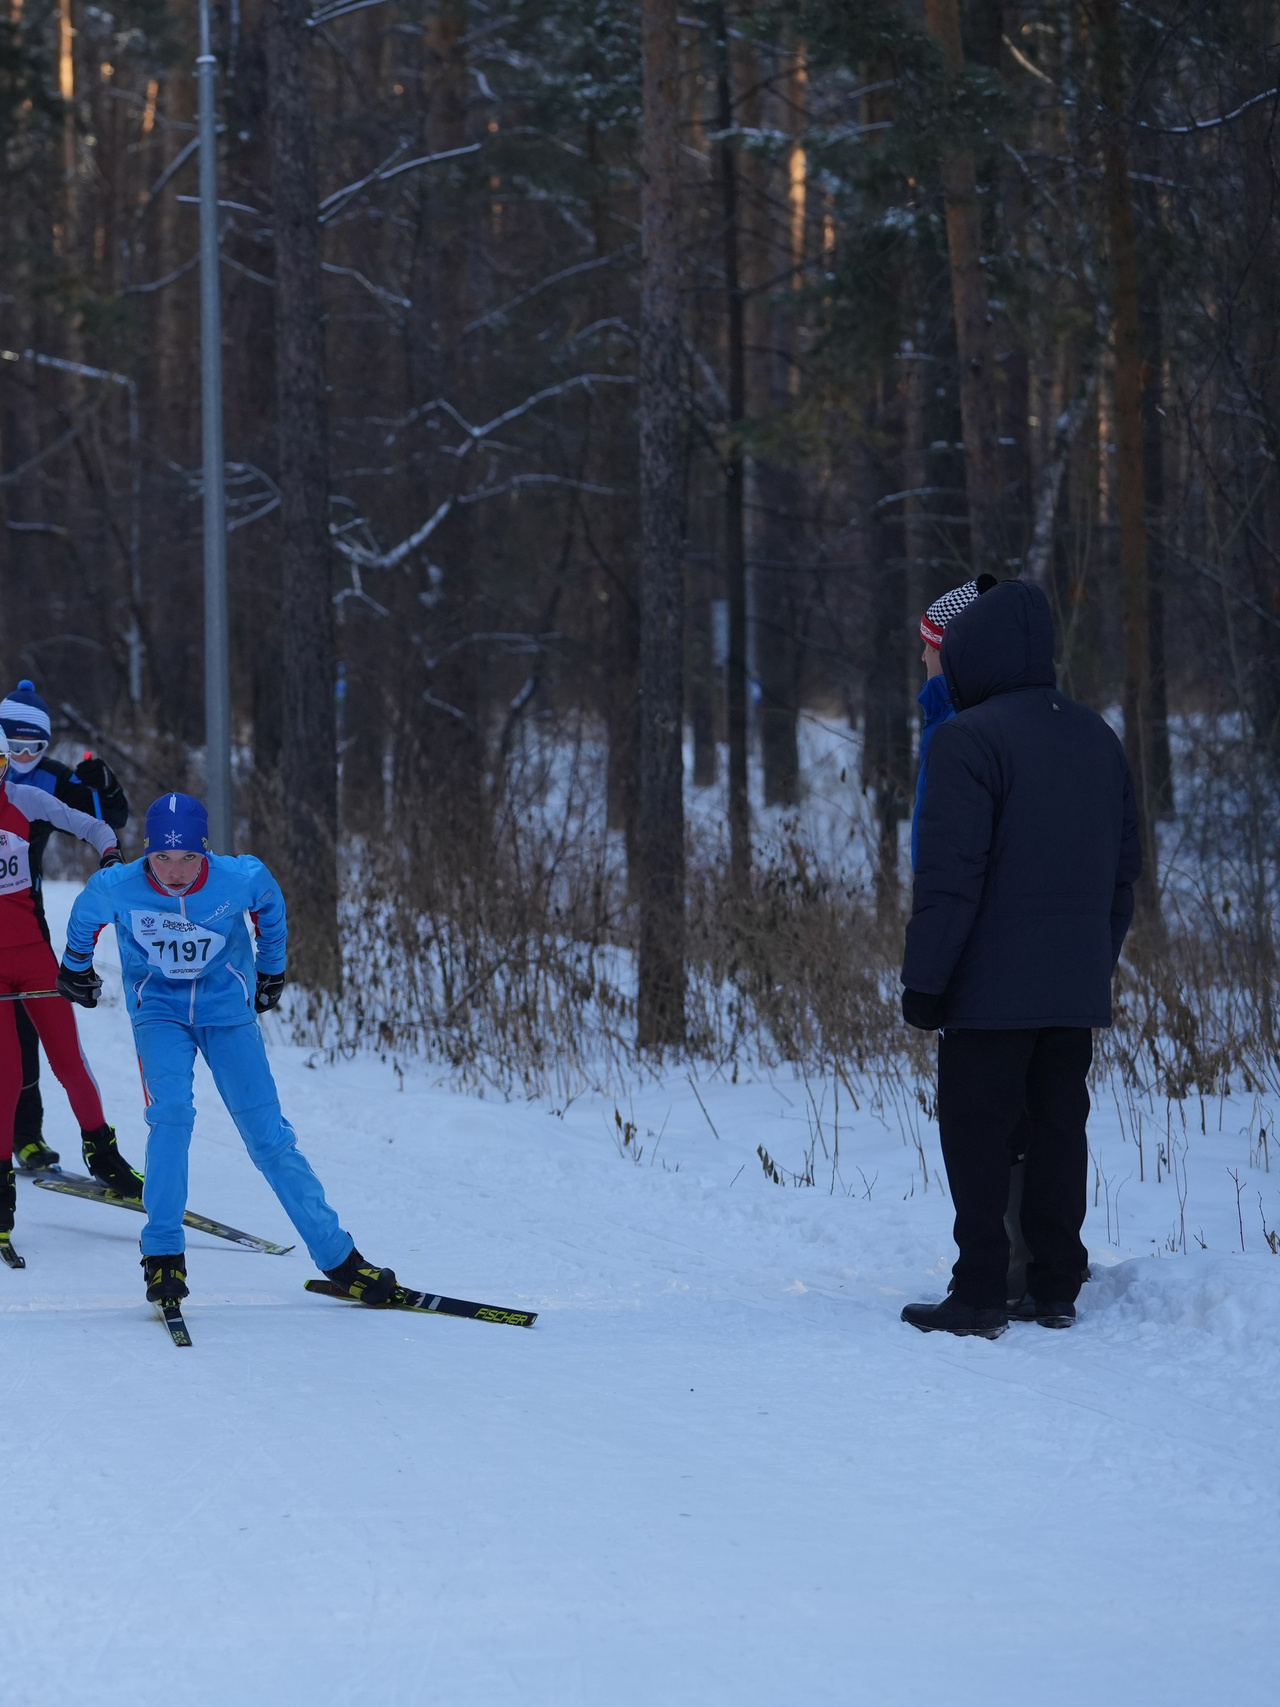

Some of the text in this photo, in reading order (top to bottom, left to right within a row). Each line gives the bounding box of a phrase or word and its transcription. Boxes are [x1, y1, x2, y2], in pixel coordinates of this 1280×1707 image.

[162, 923, 197, 932] РОССИИ
[151, 938, 212, 963] 7197
[474, 1307, 529, 1325] FISCHER
